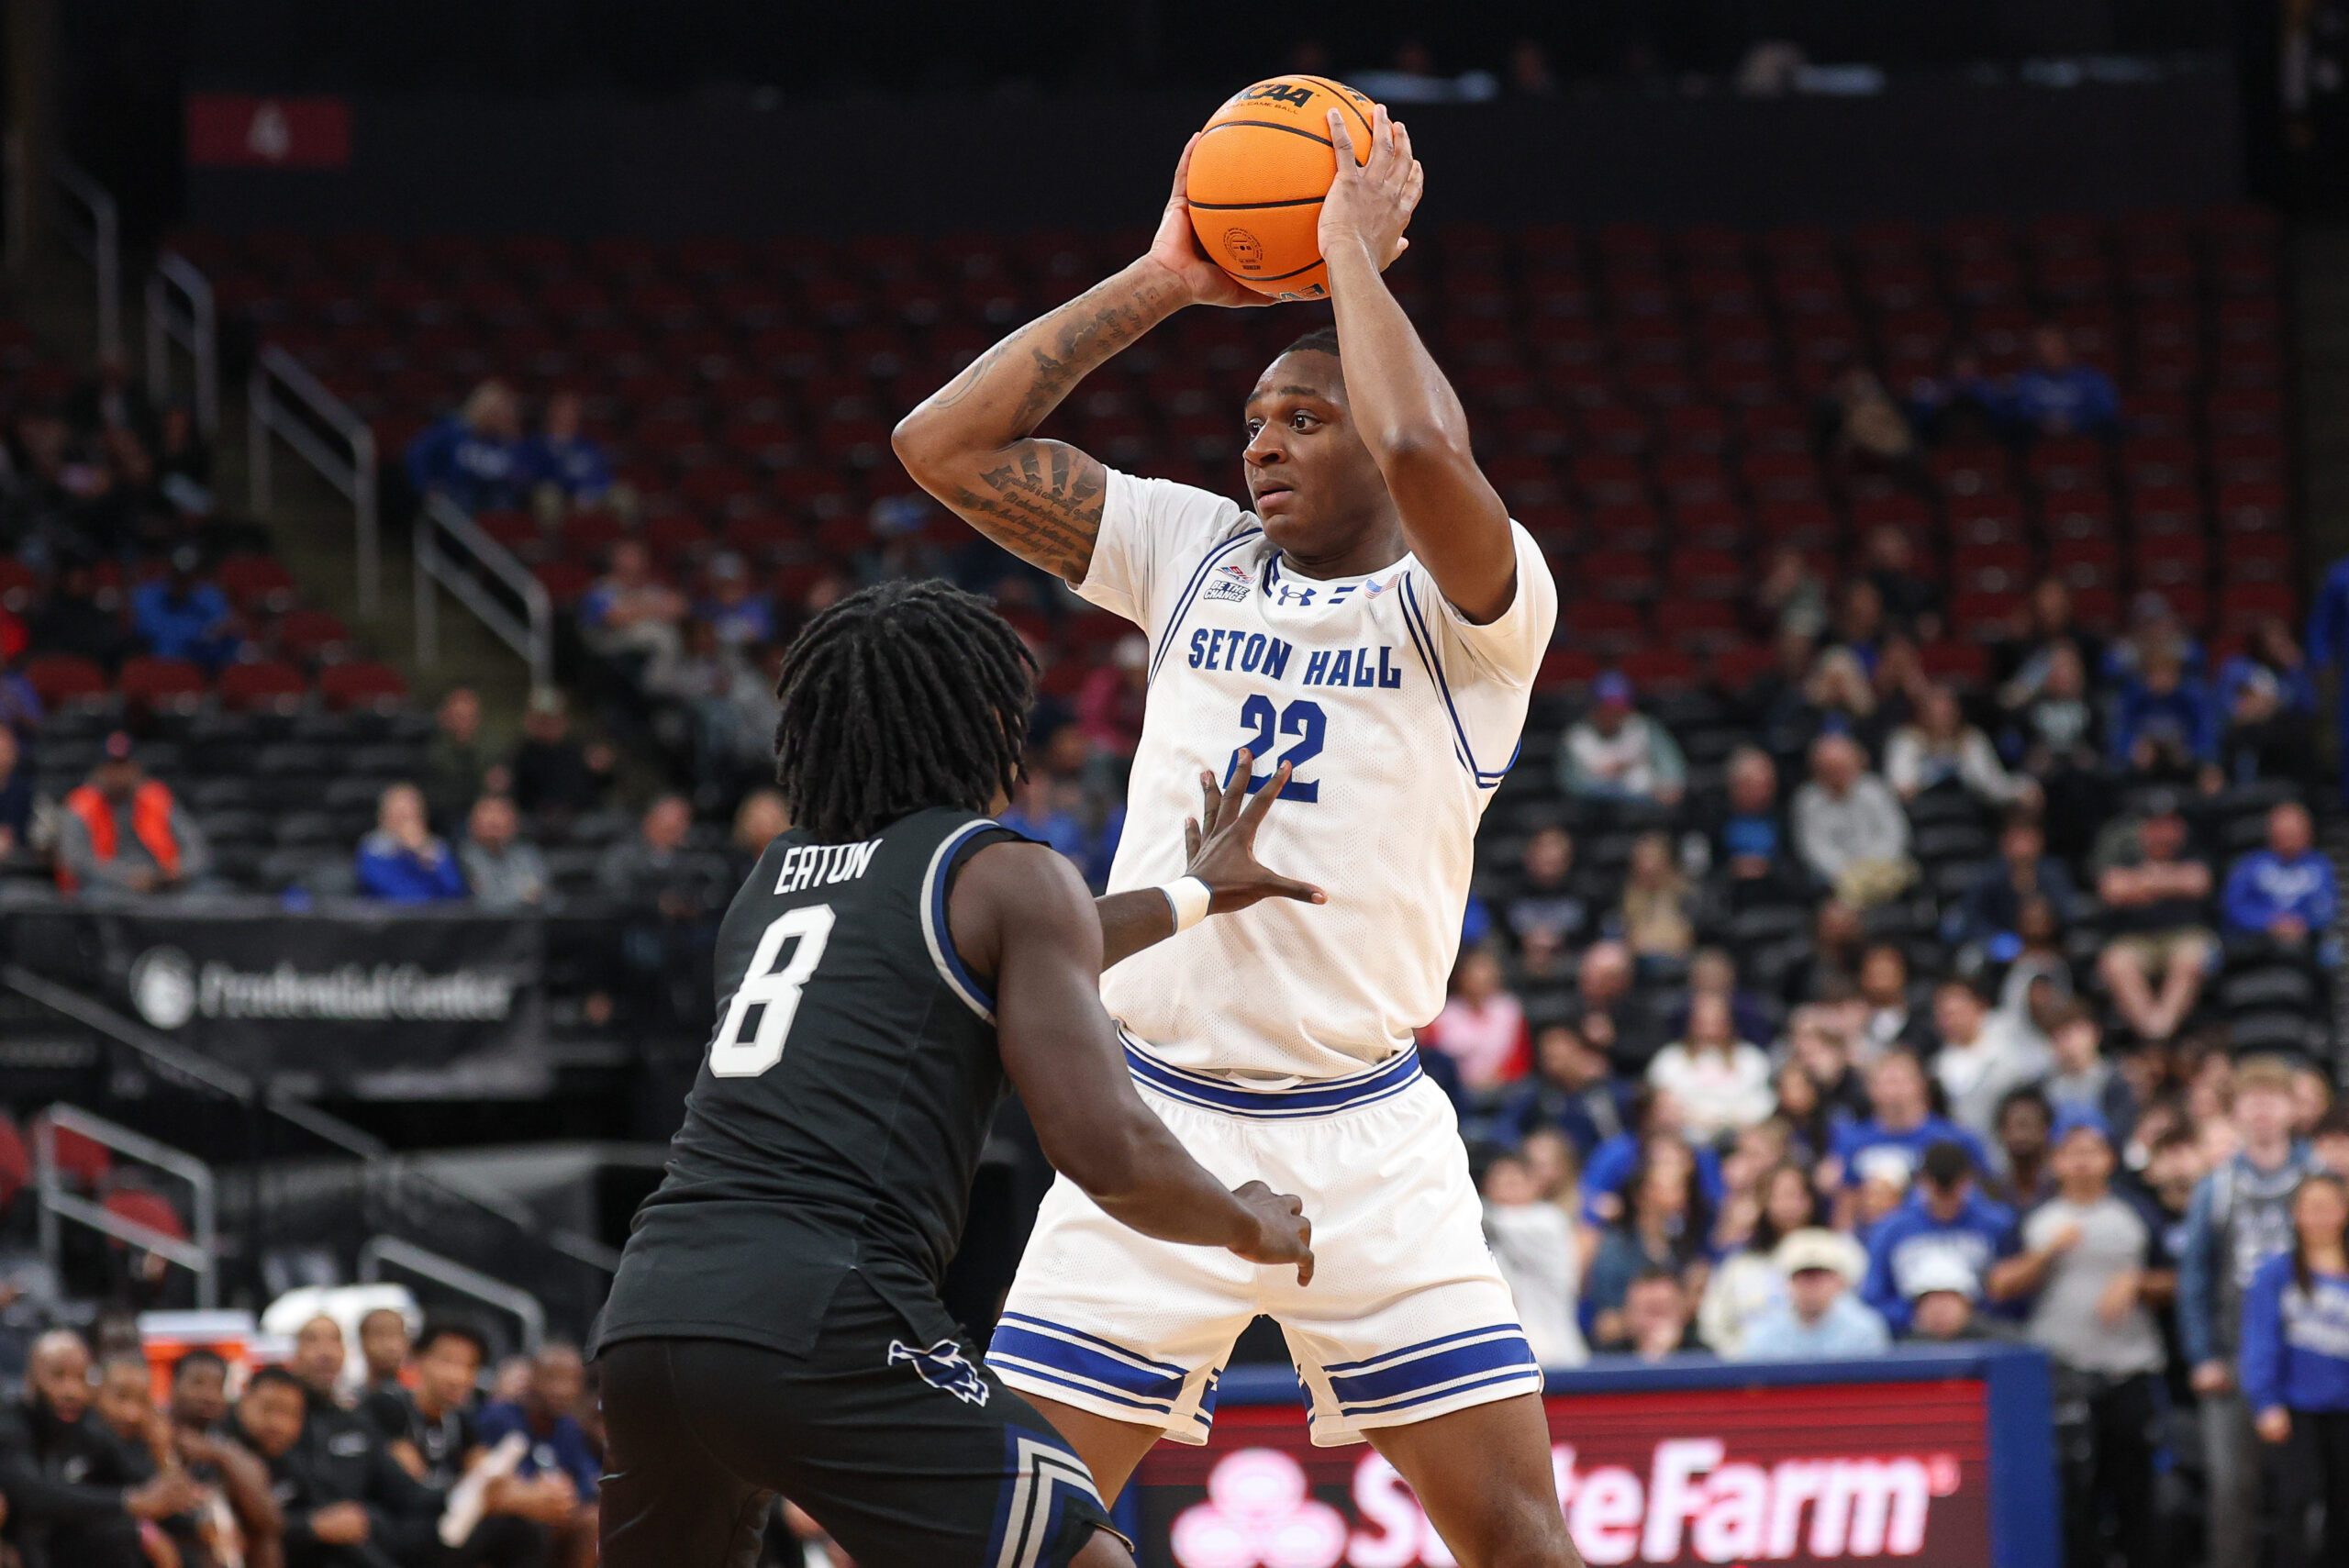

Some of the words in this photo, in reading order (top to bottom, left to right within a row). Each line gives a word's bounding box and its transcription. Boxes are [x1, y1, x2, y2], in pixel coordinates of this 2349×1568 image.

[1204, 588, 1246, 602] CHANGE
[1211, 580, 1229, 590] BE
[1228, 582, 1250, 595] THE
[1188, 628, 1293, 681] SETON
[1302, 646, 1402, 689] HALL
[1222, 694, 1327, 804] 22
[774, 839, 883, 895] EATON
[708, 903, 836, 1079] 8
